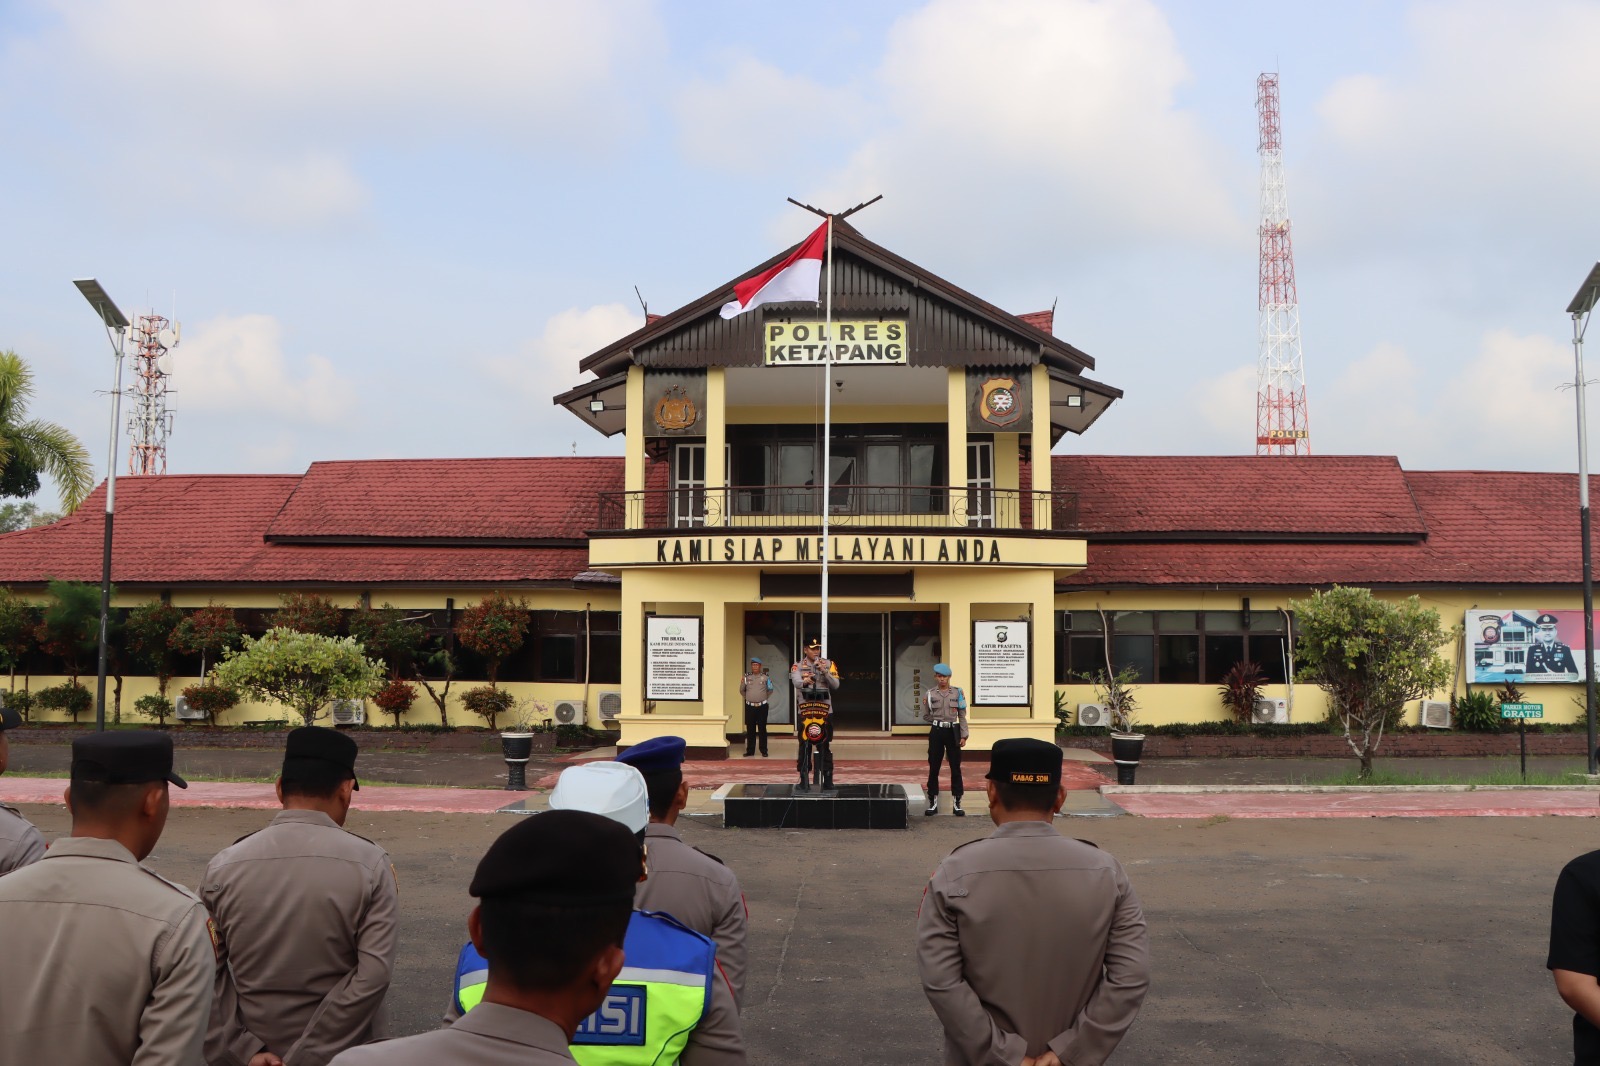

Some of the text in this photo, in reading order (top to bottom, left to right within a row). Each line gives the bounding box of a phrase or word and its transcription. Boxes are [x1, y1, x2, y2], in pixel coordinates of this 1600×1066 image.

[770, 324, 902, 342] POLRES
[770, 344, 902, 361] KETAPANG
[1270, 430, 1308, 438] POLISI
[657, 537, 1001, 562] KAMI SIAP MELAYANI ANDA
[1012, 774, 1034, 782] KABAG
[576, 995, 640, 1034] ISI
